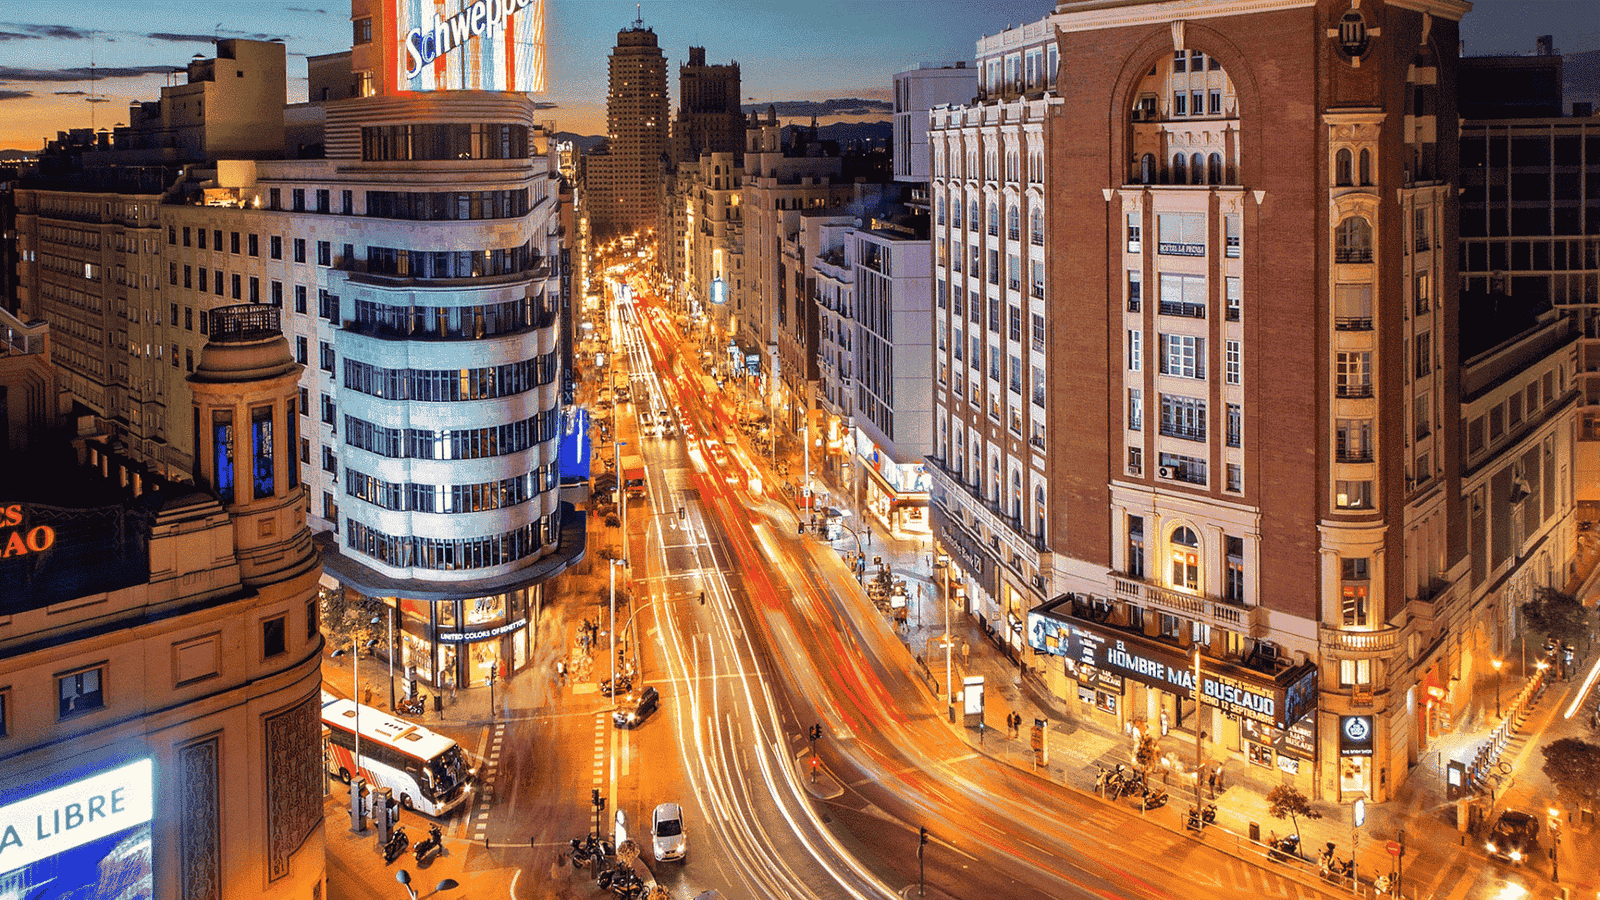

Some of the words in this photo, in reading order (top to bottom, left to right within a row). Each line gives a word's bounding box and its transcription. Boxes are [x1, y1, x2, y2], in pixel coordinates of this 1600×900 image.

[405, 0, 533, 80] Schwepp
[562, 252, 570, 309] HOTEL
[564, 368, 573, 401] REX
[0, 525, 55, 558] AO
[440, 633, 463, 641] UNITED
[464, 630, 490, 640] COLORS
[500, 618, 527, 634] BENETTON
[1116, 639, 1126, 652] EL
[1107, 647, 1164, 680] HOMBRE
[1167, 666, 1201, 691] MÁS
[1204, 678, 1275, 716] BUSCADO
[1189, 688, 1219, 707] ESRENO
[1220, 700, 1229, 711] 12
[1230, 703, 1275, 726] SEPTIEMBRE
[0, 824, 23, 855] A
[37, 786, 126, 841] LIBRE
